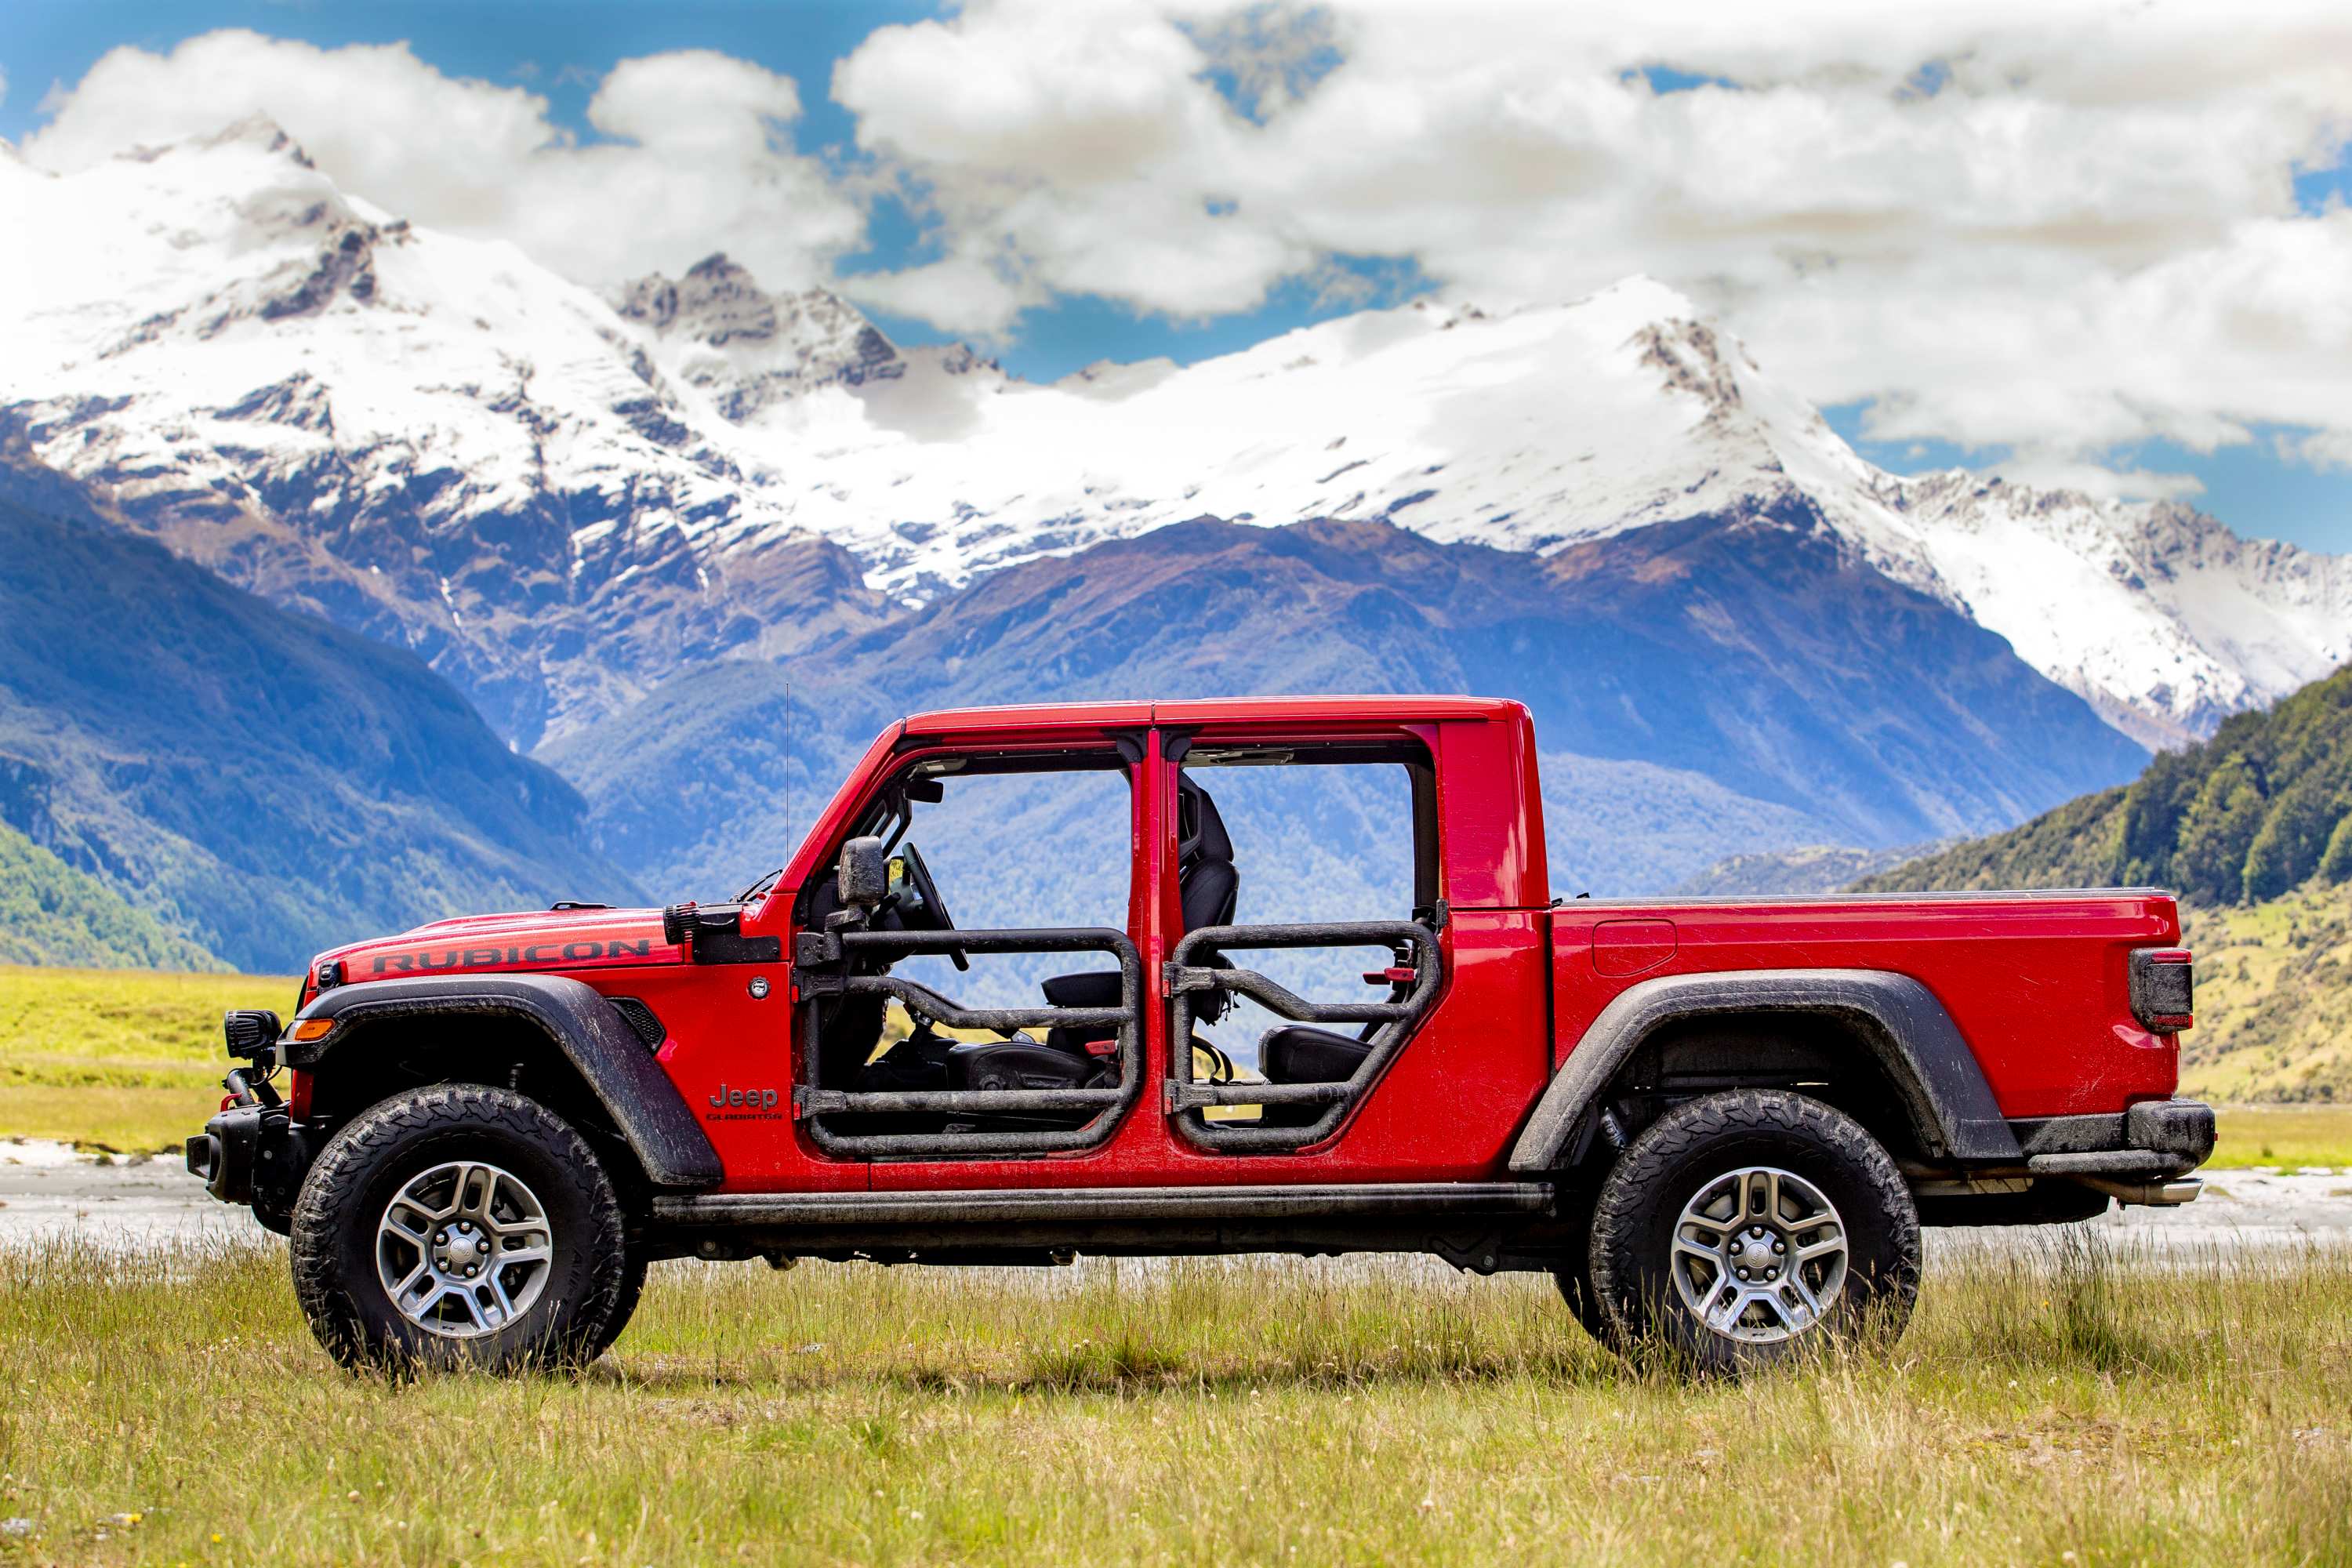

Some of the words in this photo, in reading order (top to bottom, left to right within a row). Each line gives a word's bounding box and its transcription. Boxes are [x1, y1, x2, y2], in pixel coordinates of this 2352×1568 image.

[372, 939, 651, 973] RUBICON
[709, 1083, 778, 1110] Jeep
[452, 1241, 470, 1257] Jeep
